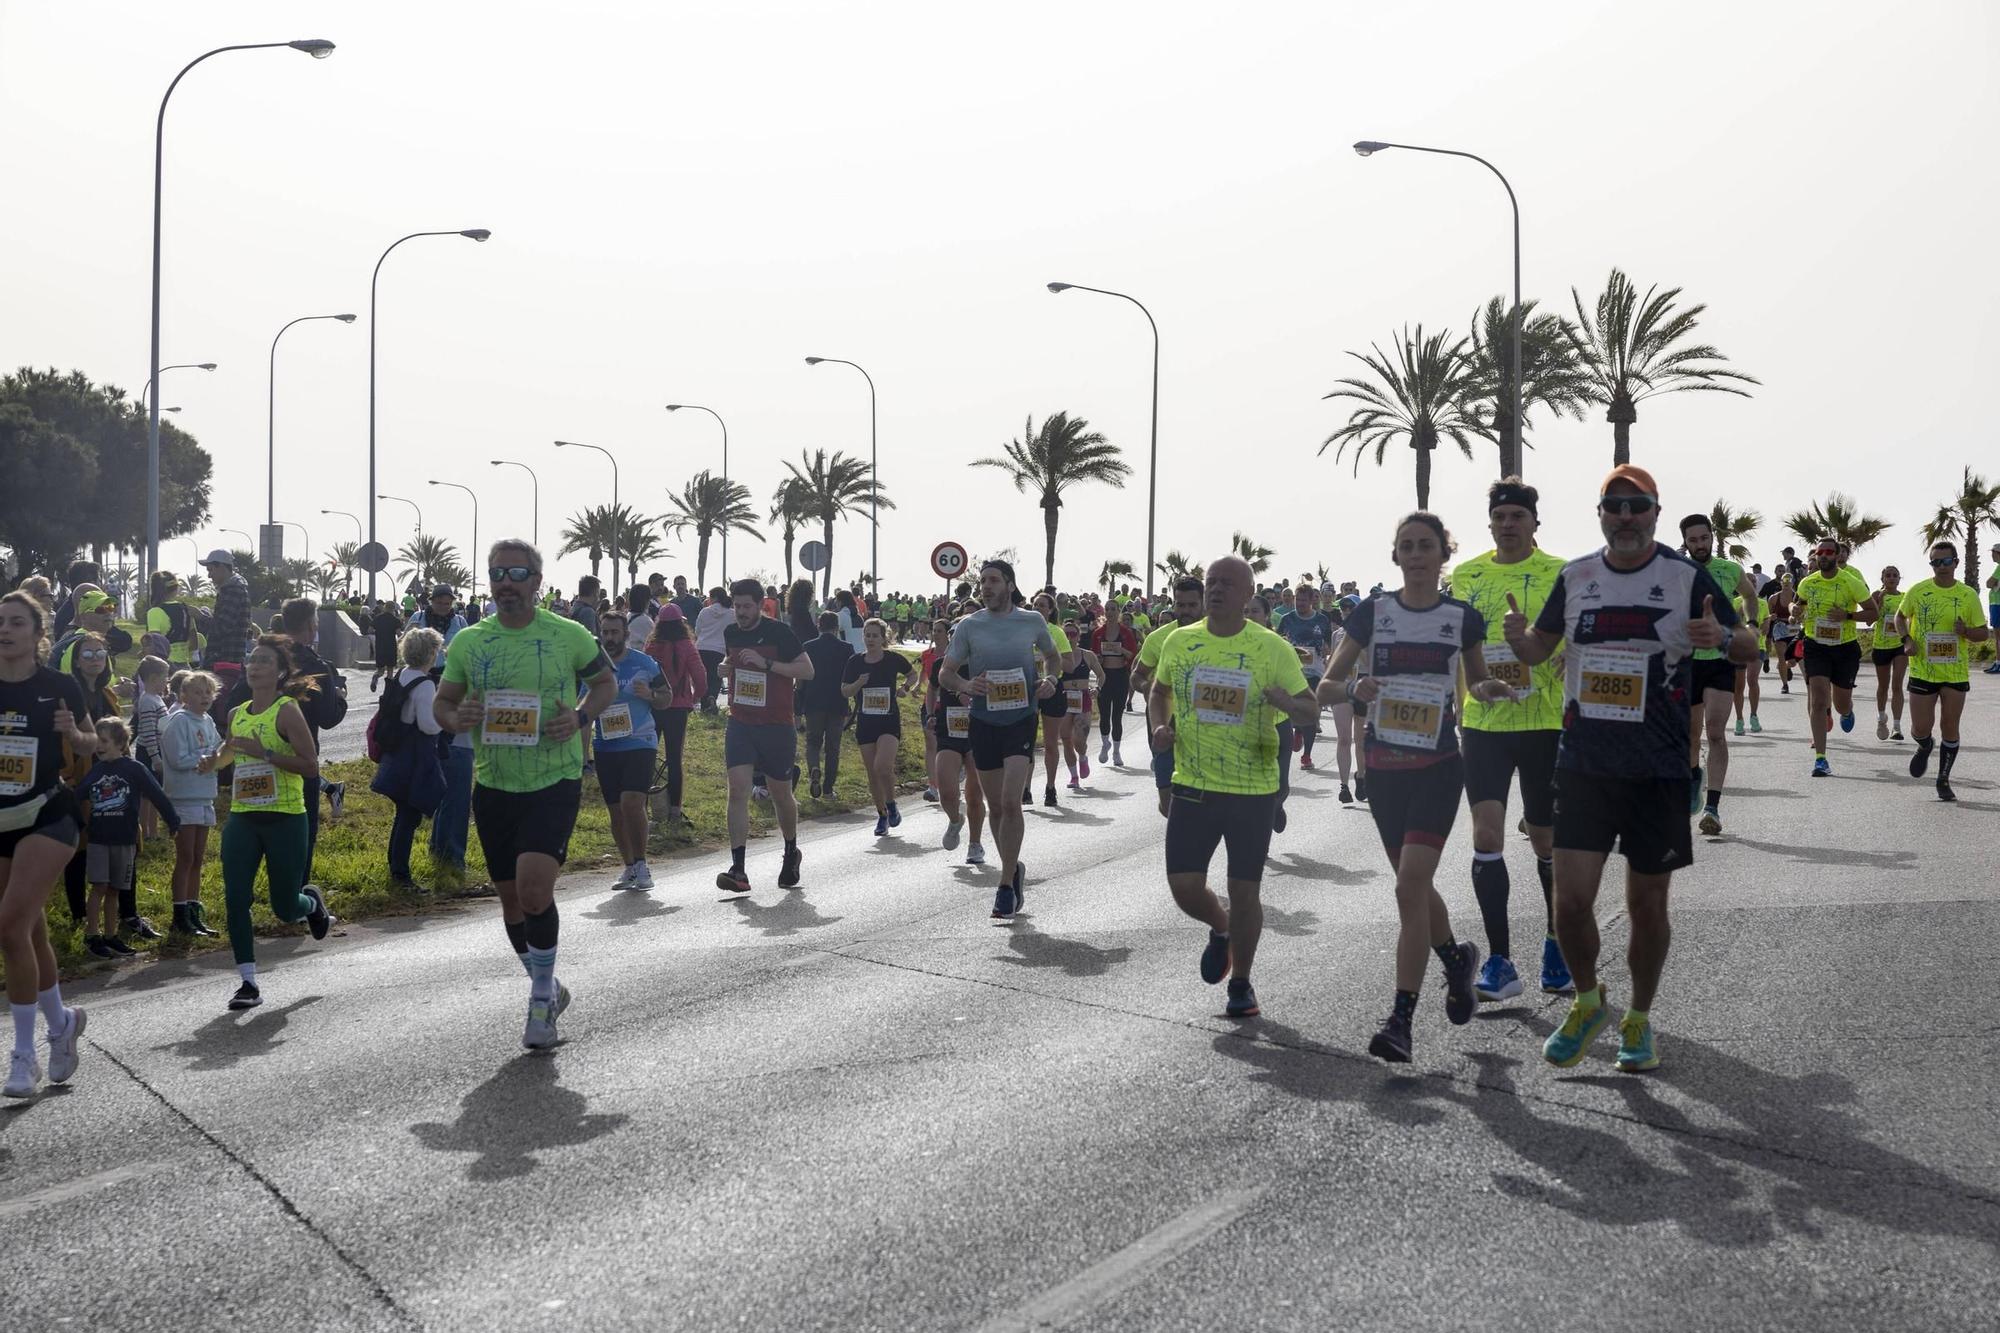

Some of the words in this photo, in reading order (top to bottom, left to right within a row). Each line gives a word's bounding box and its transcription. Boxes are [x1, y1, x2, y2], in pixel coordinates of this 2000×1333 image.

[939, 554, 960, 567] 60
[996, 684, 1020, 696] 1915
[1590, 676, 1632, 696] 2885
[1202, 687, 1237, 704] 2012
[495, 711, 529, 726] 2234
[1391, 703, 1429, 724] 1671
[240, 777, 269, 791] 2566
